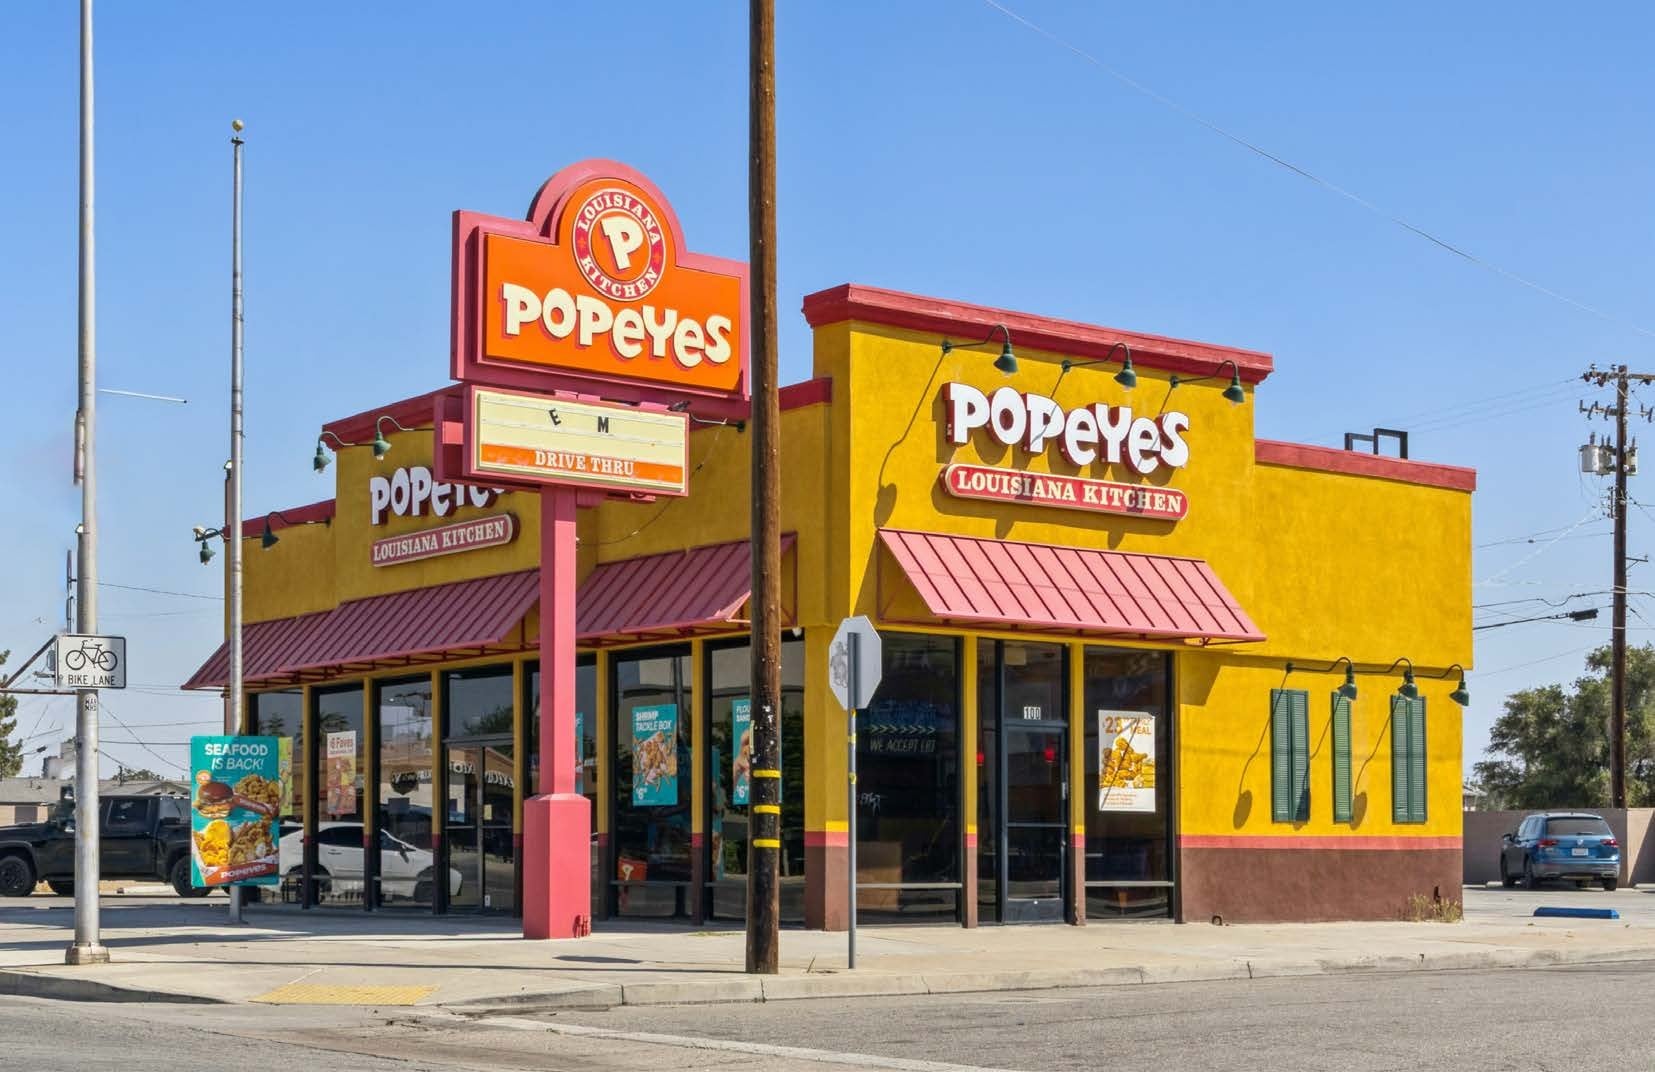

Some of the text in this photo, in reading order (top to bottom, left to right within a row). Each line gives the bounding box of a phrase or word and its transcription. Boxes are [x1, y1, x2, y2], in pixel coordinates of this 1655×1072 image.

[577, 191, 662, 246] LOUISIANA
[600, 216, 644, 271] P
[580, 254, 659, 299] KITCHEN
[548, 407, 610, 434] E M
[534, 451, 635, 477] DRIVE THRU
[957, 470, 1182, 513] LOUISIANA KITCHEN
[373, 520, 505, 561] LOUISIANA KITCHEN
[67, 674, 116, 686] BIKE LANE
[636, 711, 659, 721] SHRIMP
[1024, 706, 1041, 720] 100
[636, 720, 672, 732] TACKLE BOX
[205, 744, 269, 756] SEAFOOD
[869, 738, 885, 752] WE
[887, 739, 919, 752] ACCEPT
[211, 758, 264, 771] IS BACK!
